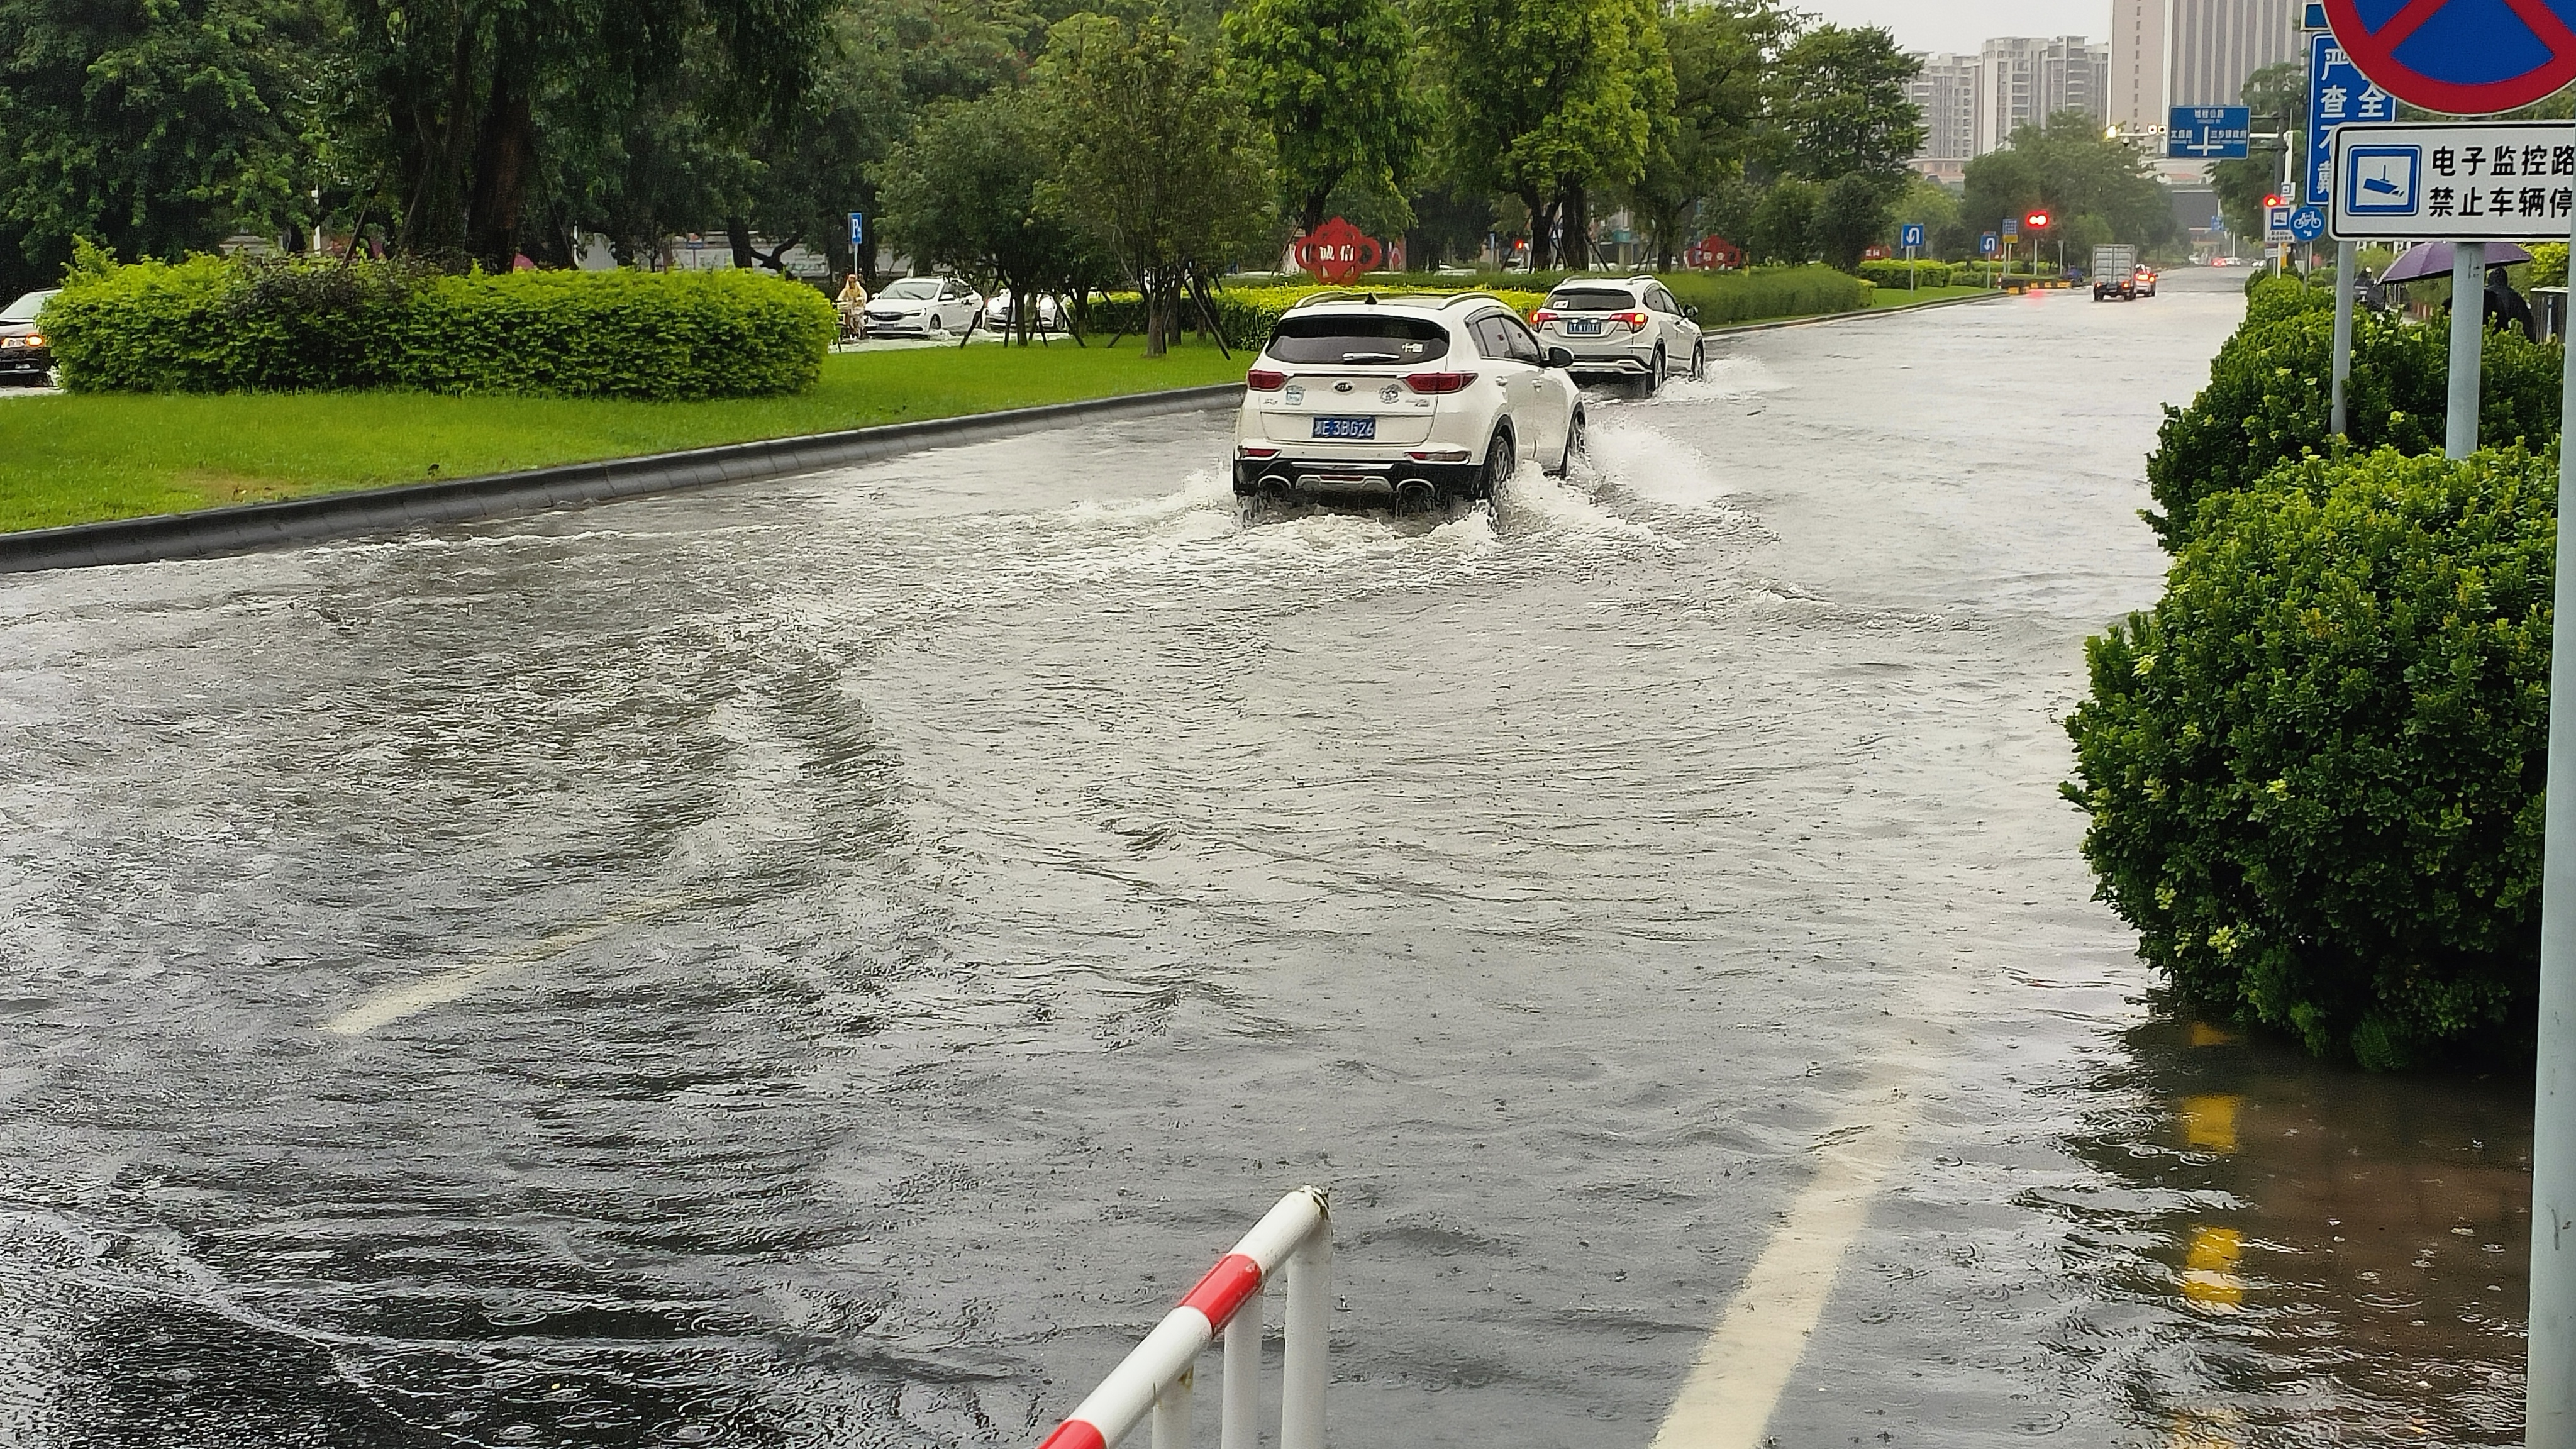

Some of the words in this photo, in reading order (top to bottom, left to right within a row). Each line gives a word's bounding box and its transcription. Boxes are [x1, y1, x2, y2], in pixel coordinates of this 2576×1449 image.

[2432, 145, 2575, 176] 电子监控路
[2429, 186, 2572, 218] 禁止车辆停
